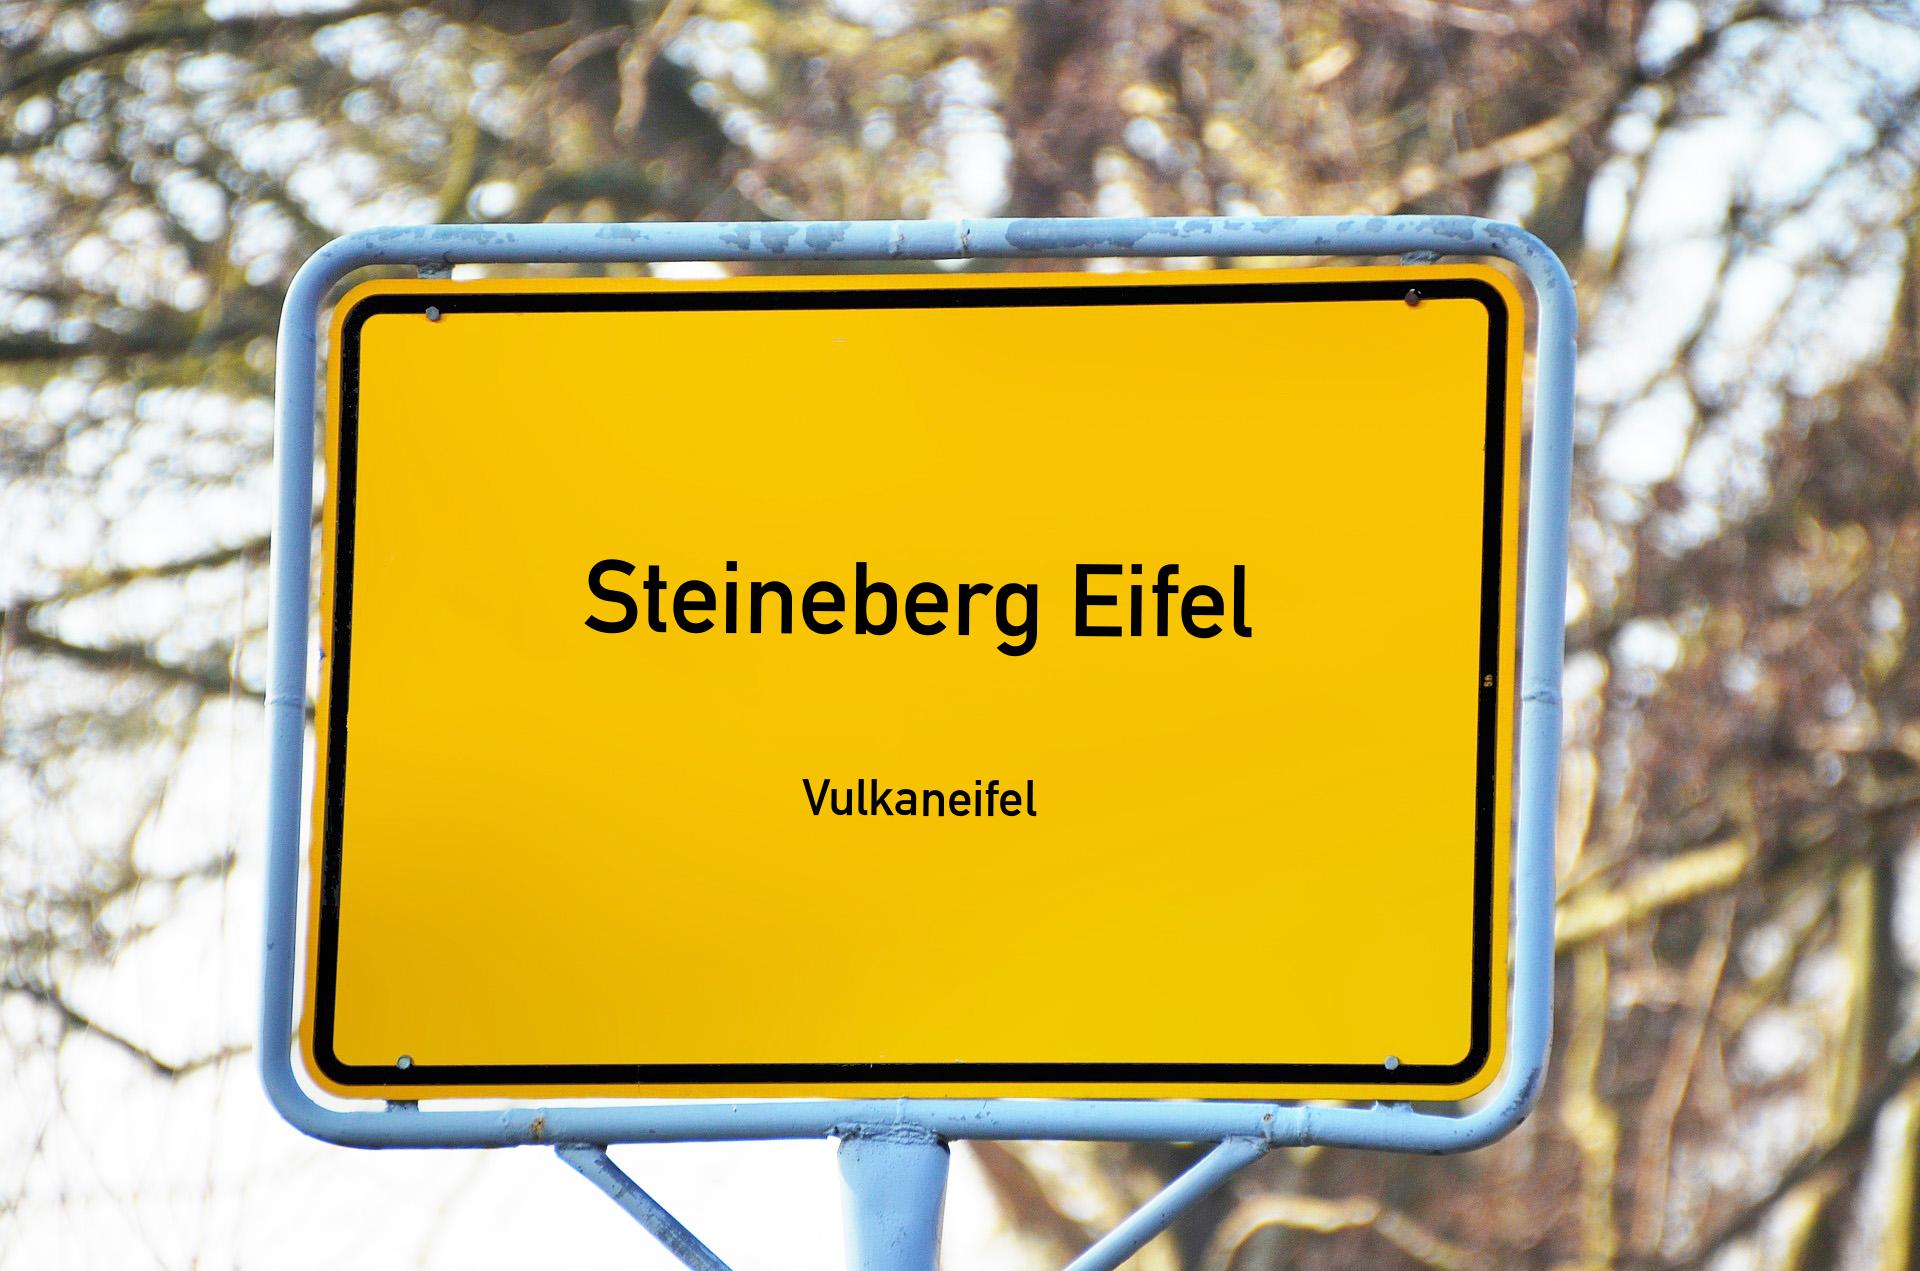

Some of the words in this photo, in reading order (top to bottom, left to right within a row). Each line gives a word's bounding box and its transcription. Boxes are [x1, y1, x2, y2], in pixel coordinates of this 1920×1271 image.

[584, 558, 1038, 657] Steineberg
[1075, 563, 1253, 639] Eifel
[802, 778, 1037, 817] Vulkaneifel
